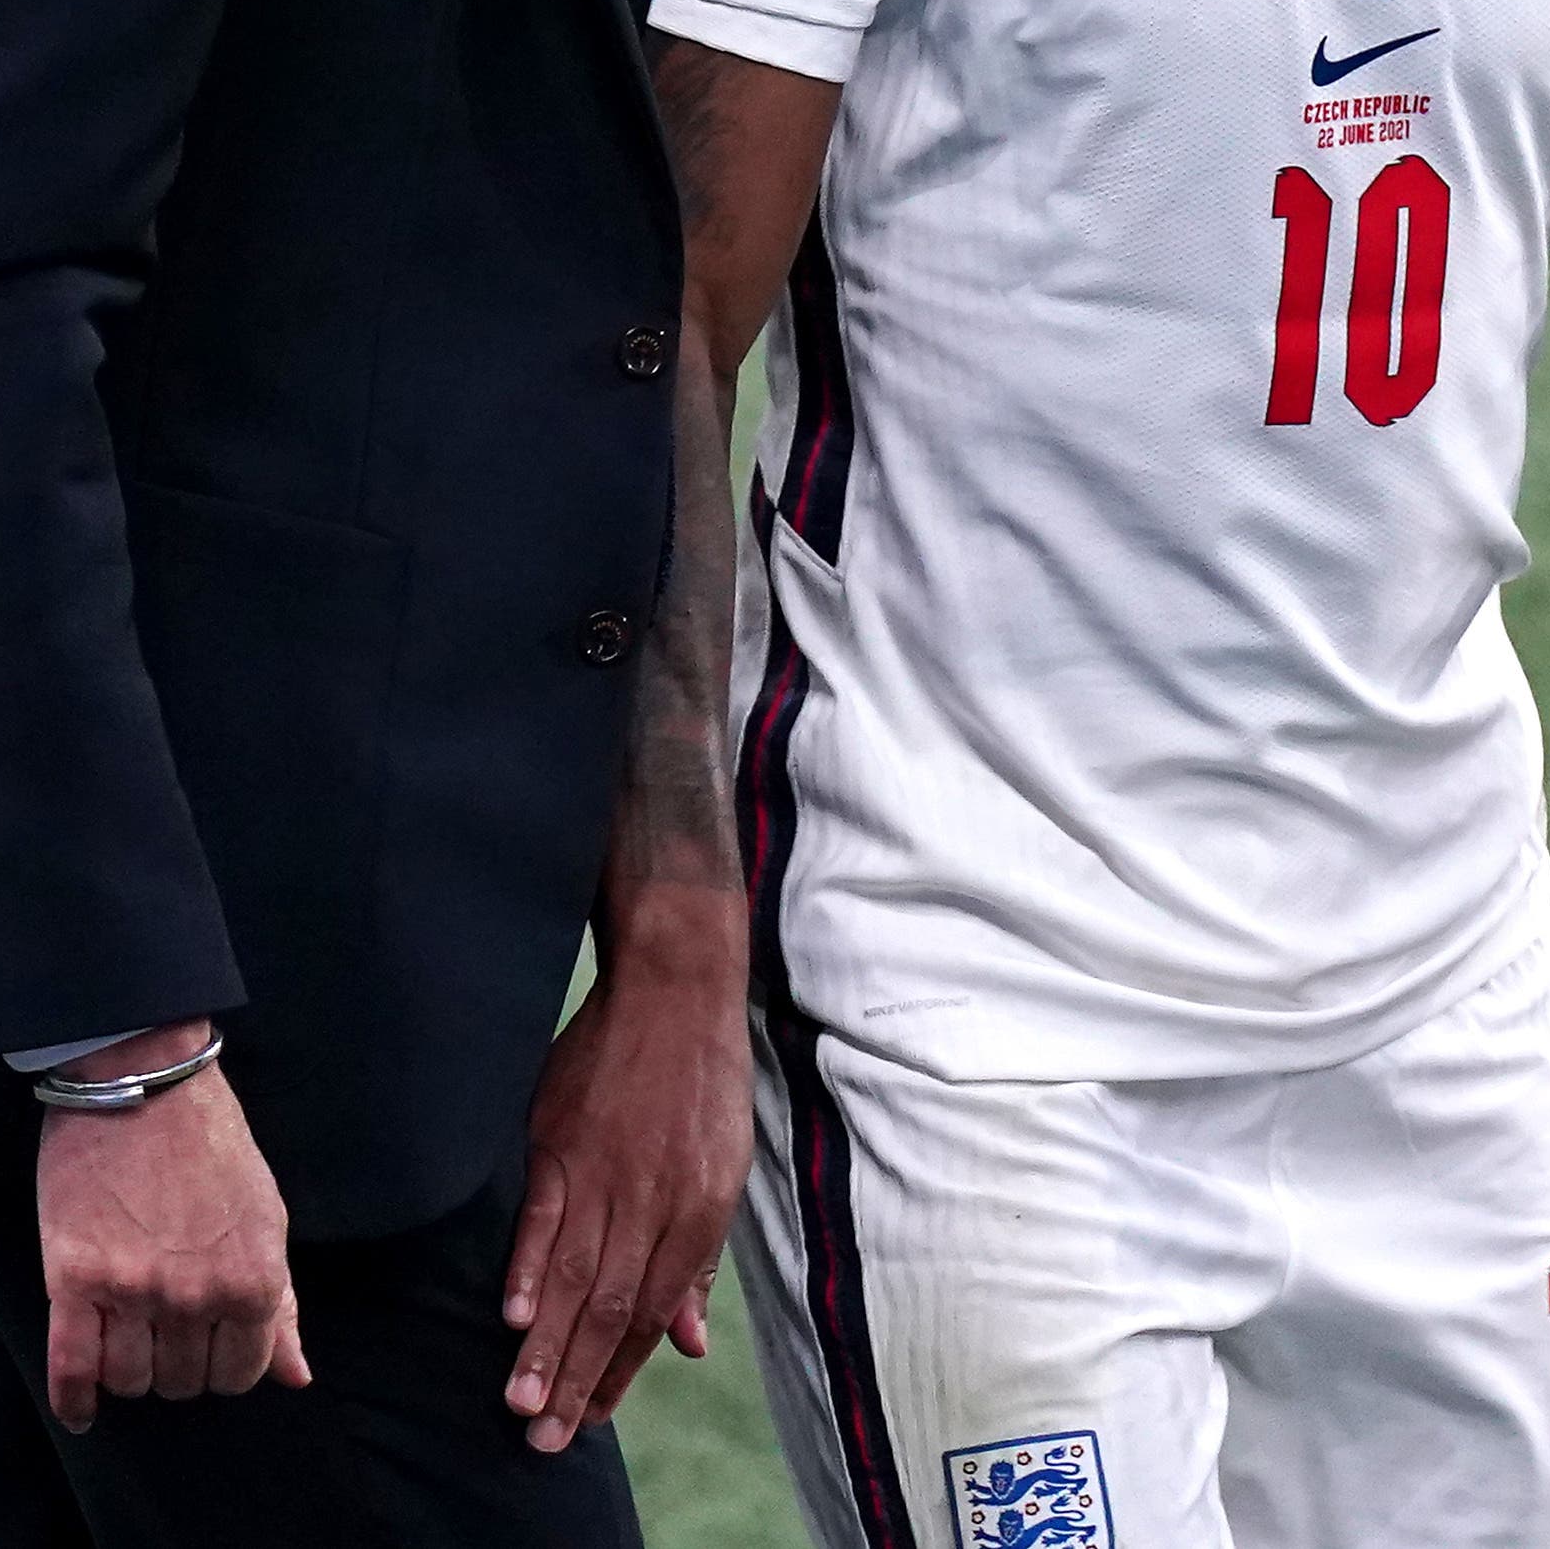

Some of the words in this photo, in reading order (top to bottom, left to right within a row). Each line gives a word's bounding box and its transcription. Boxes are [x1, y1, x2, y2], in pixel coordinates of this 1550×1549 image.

[1303, 100, 1349, 124] CZECH
[1352, 94, 1431, 119] REPUBLIC
[1317, 127, 1334, 149] 22
[1339, 123, 1375, 146] JUNE
[1379, 119, 1410, 142] 2021
[1265, 154, 1451, 427] 10
